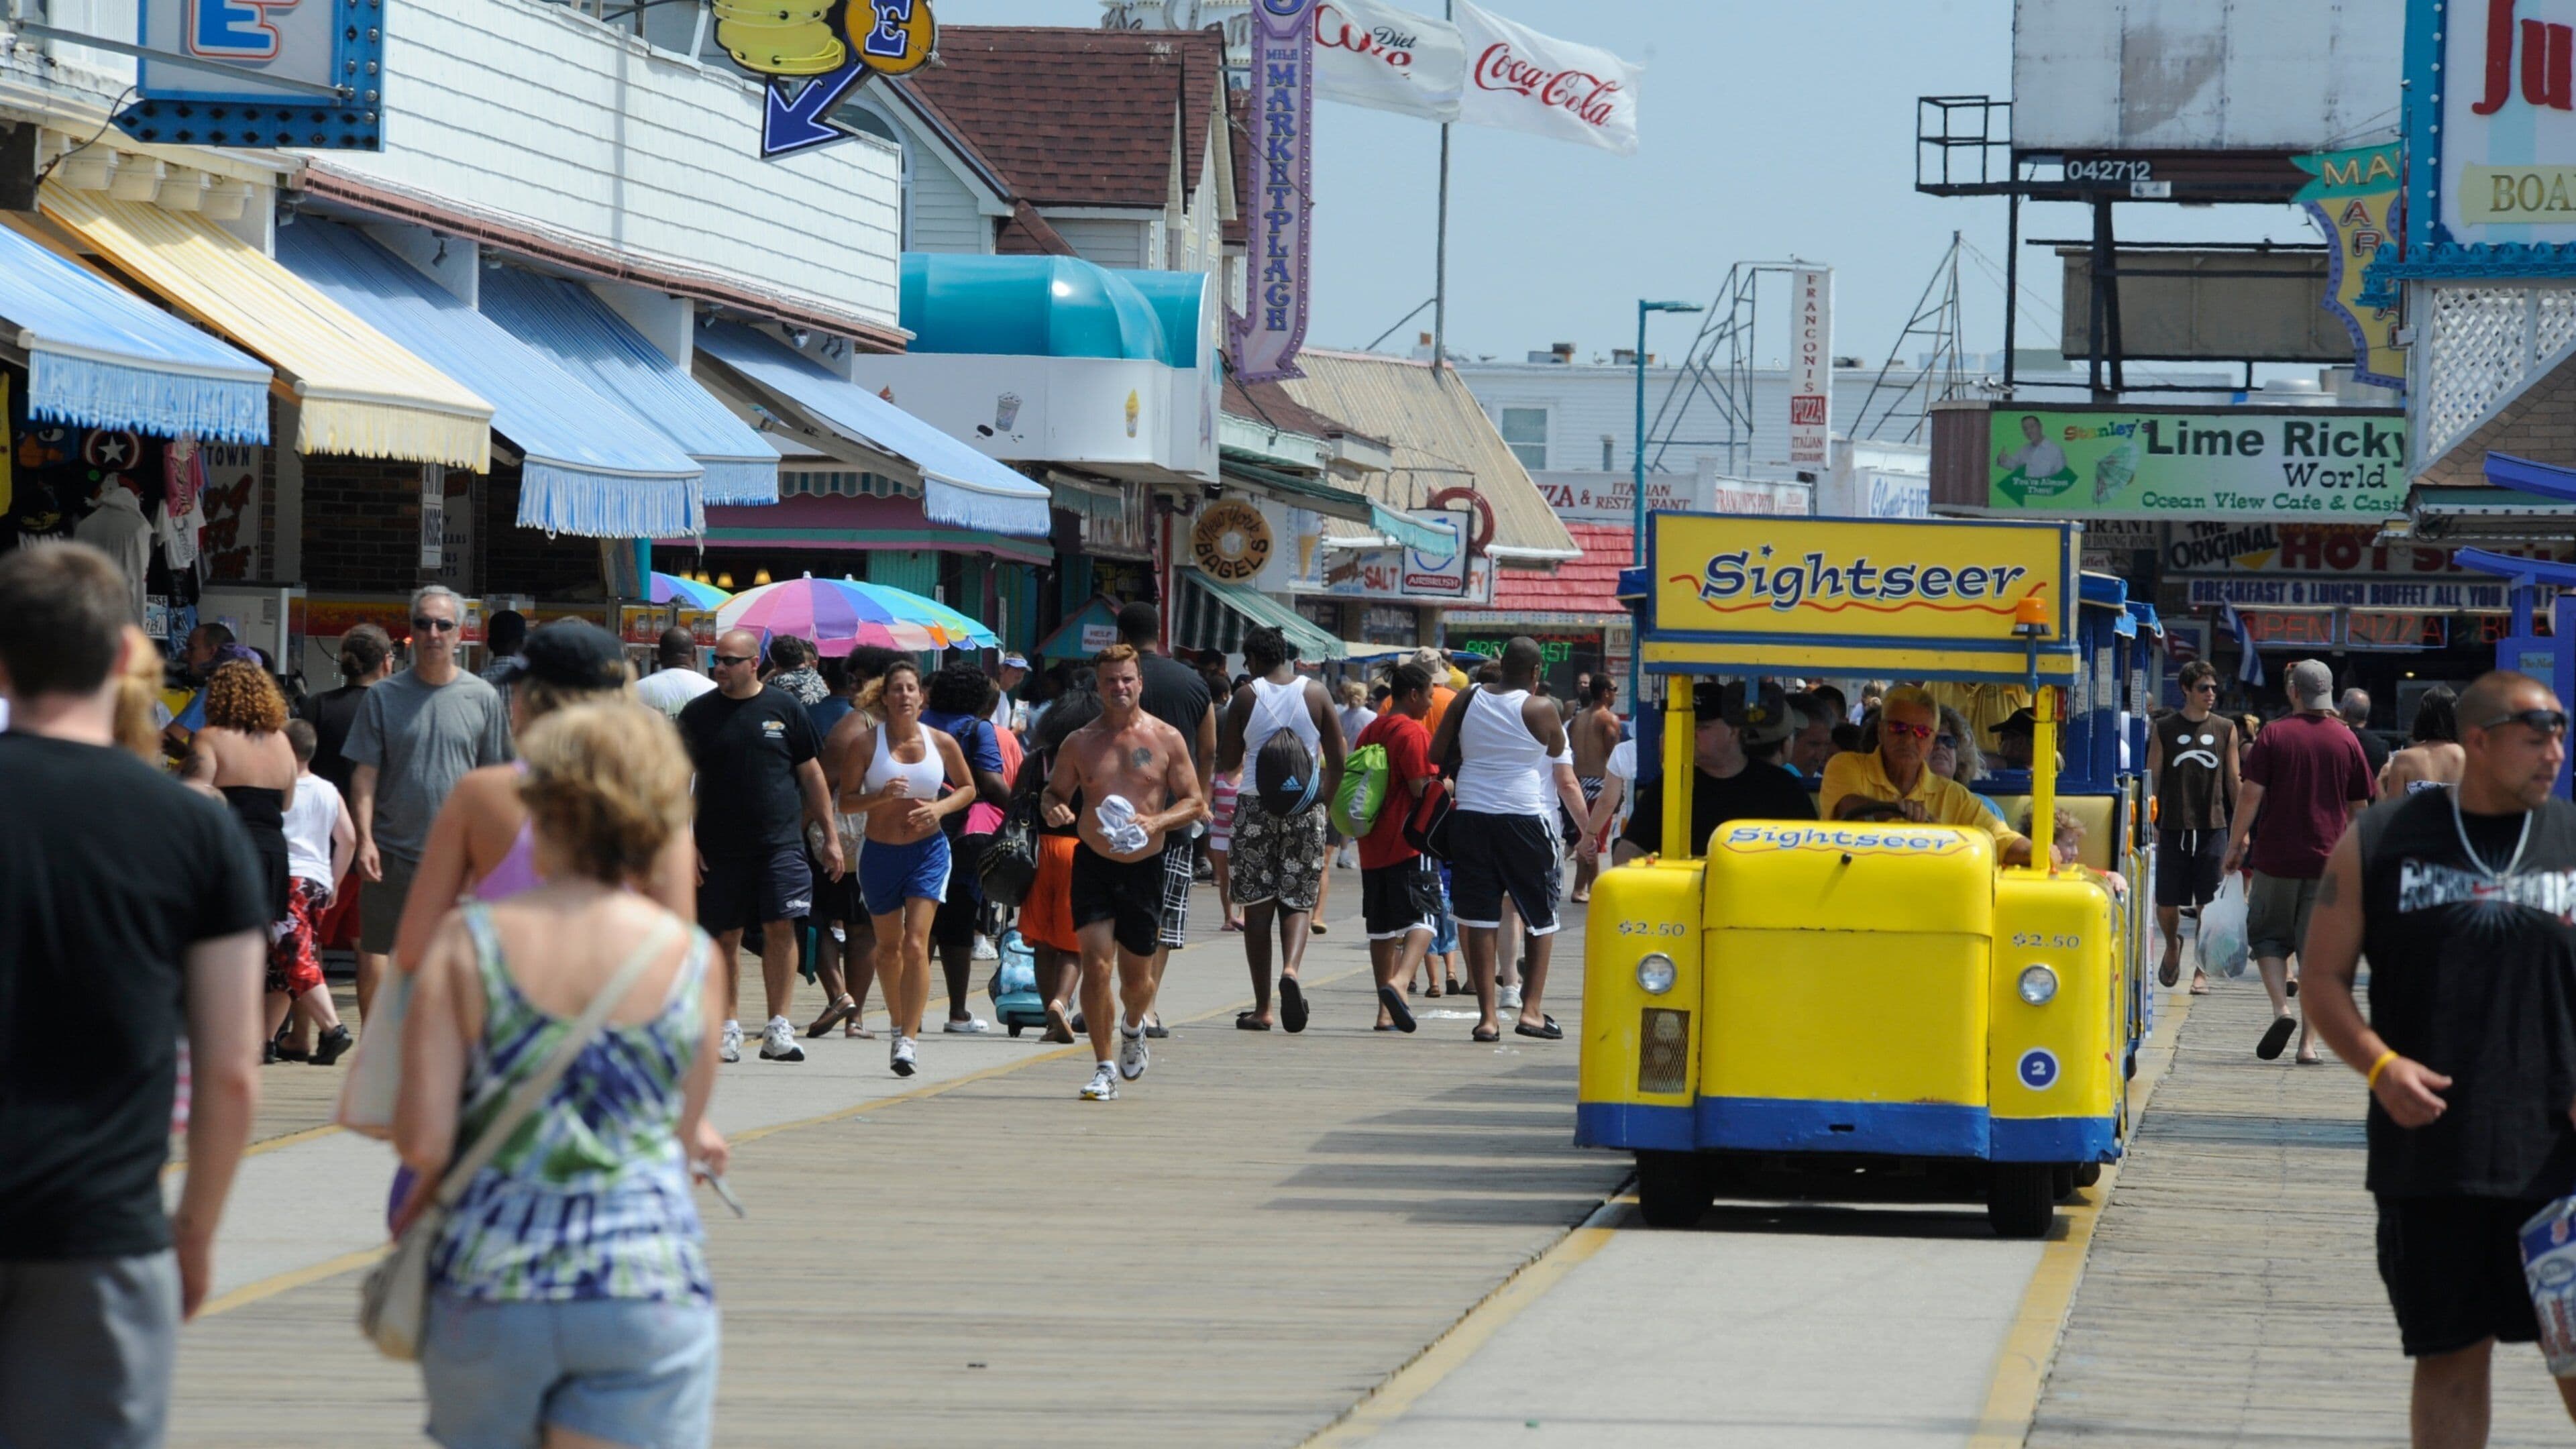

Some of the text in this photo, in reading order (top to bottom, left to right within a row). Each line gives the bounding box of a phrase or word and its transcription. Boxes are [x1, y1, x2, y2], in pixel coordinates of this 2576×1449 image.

[1373, 26, 1416, 48] Diet
[1266, 48, 1299, 60] MILE
[2067, 160, 2151, 180] 042712
[1264, 63, 1297, 331] MARKETPLACE
[2489, 173, 2576, 213] BOA
[1792, 398, 1823, 424] PIZZA
[2148, 419, 2265, 457] Lime
[207, 446, 250, 466] TOWN
[2283, 463, 2388, 489] World
[1580, 488, 1591, 504] &
[1612, 482, 1670, 496] ITAIAN
[2142, 492, 2206, 508] Ocean
[2214, 492, 2265, 509] View
[2273, 493, 2322, 510] Cafe
[2329, 496, 2346, 511] &
[2171, 523, 2279, 569] ORIGINAL
[1195, 539, 1269, 578] BAGELS
[1364, 566, 1398, 590] SALT
[1407, 576, 1459, 588] AIRBRUSH
[1700, 544, 2027, 611] Sightseer
[2311, 582, 2365, 604] LUNCH
[2371, 584, 2427, 604] BUFFET
[2434, 586, 2461, 606] ALL
[2469, 586, 2502, 606] YOU
[2349, 613, 2444, 646] PIZZA
[1728, 826, 1957, 850] Sightseer
[1618, 920, 1685, 936] $2.50
[2012, 931, 2080, 948] $2.50
[2031, 1061, 2046, 1075] 2
